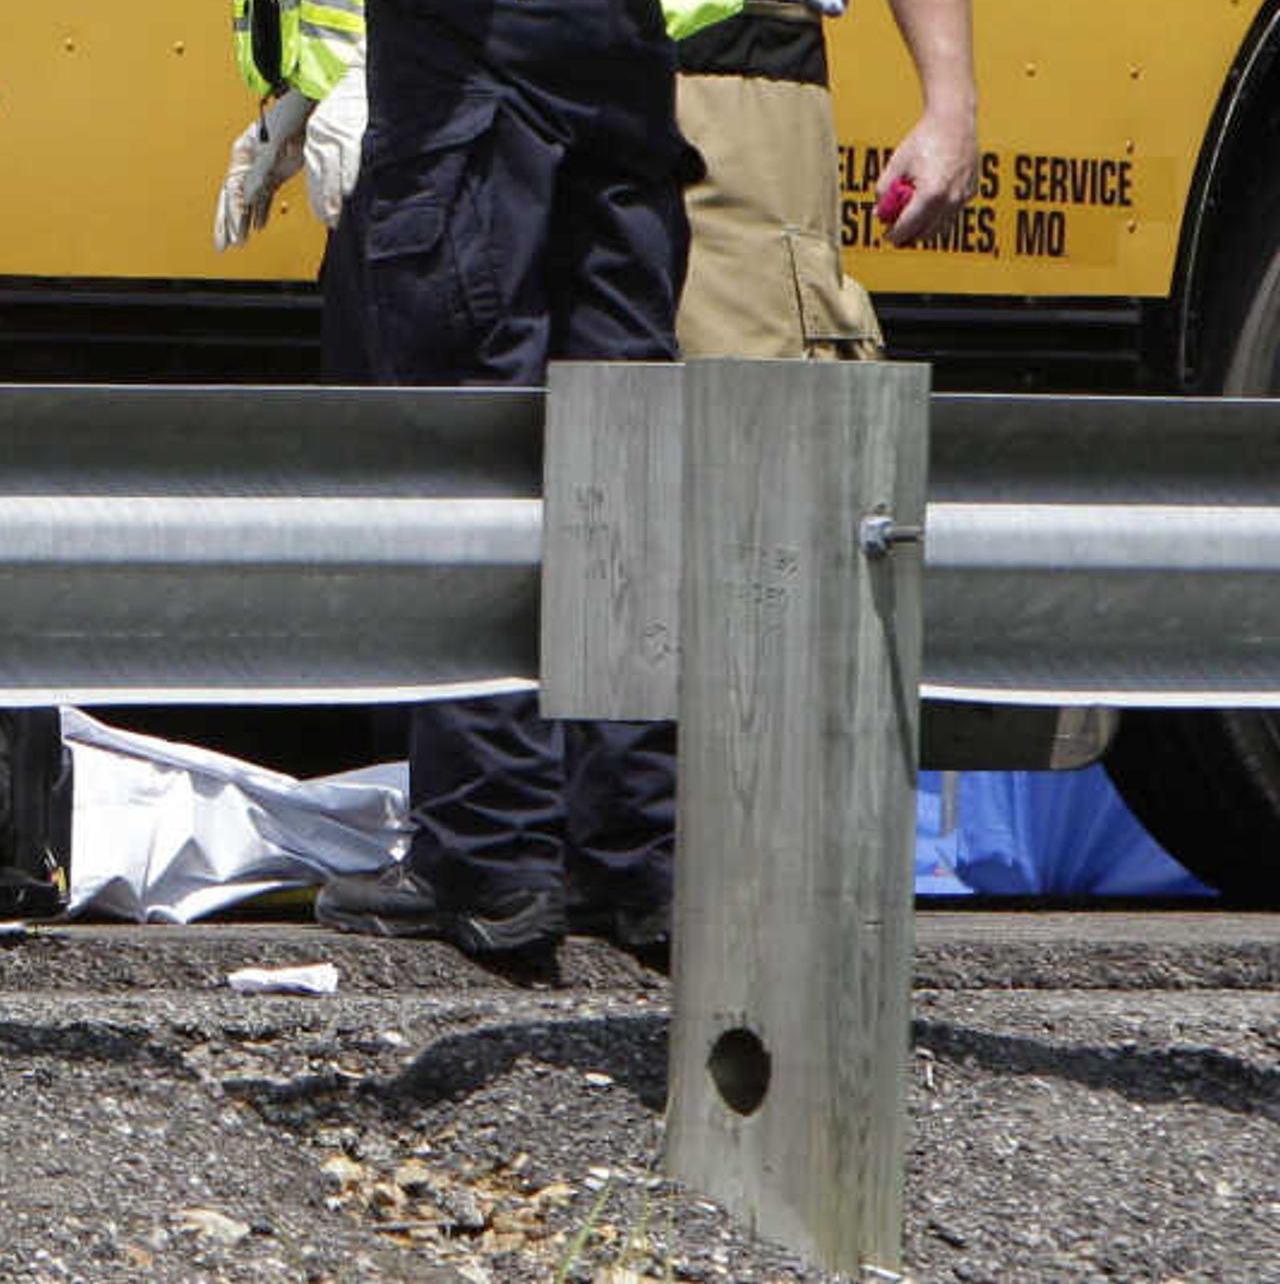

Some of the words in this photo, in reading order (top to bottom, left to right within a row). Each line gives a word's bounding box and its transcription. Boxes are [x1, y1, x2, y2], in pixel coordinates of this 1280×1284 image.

[1014, 154, 1133, 207] SERVICE
[841, 200, 880, 248] ST.
[1016, 210, 1066, 257] MO
